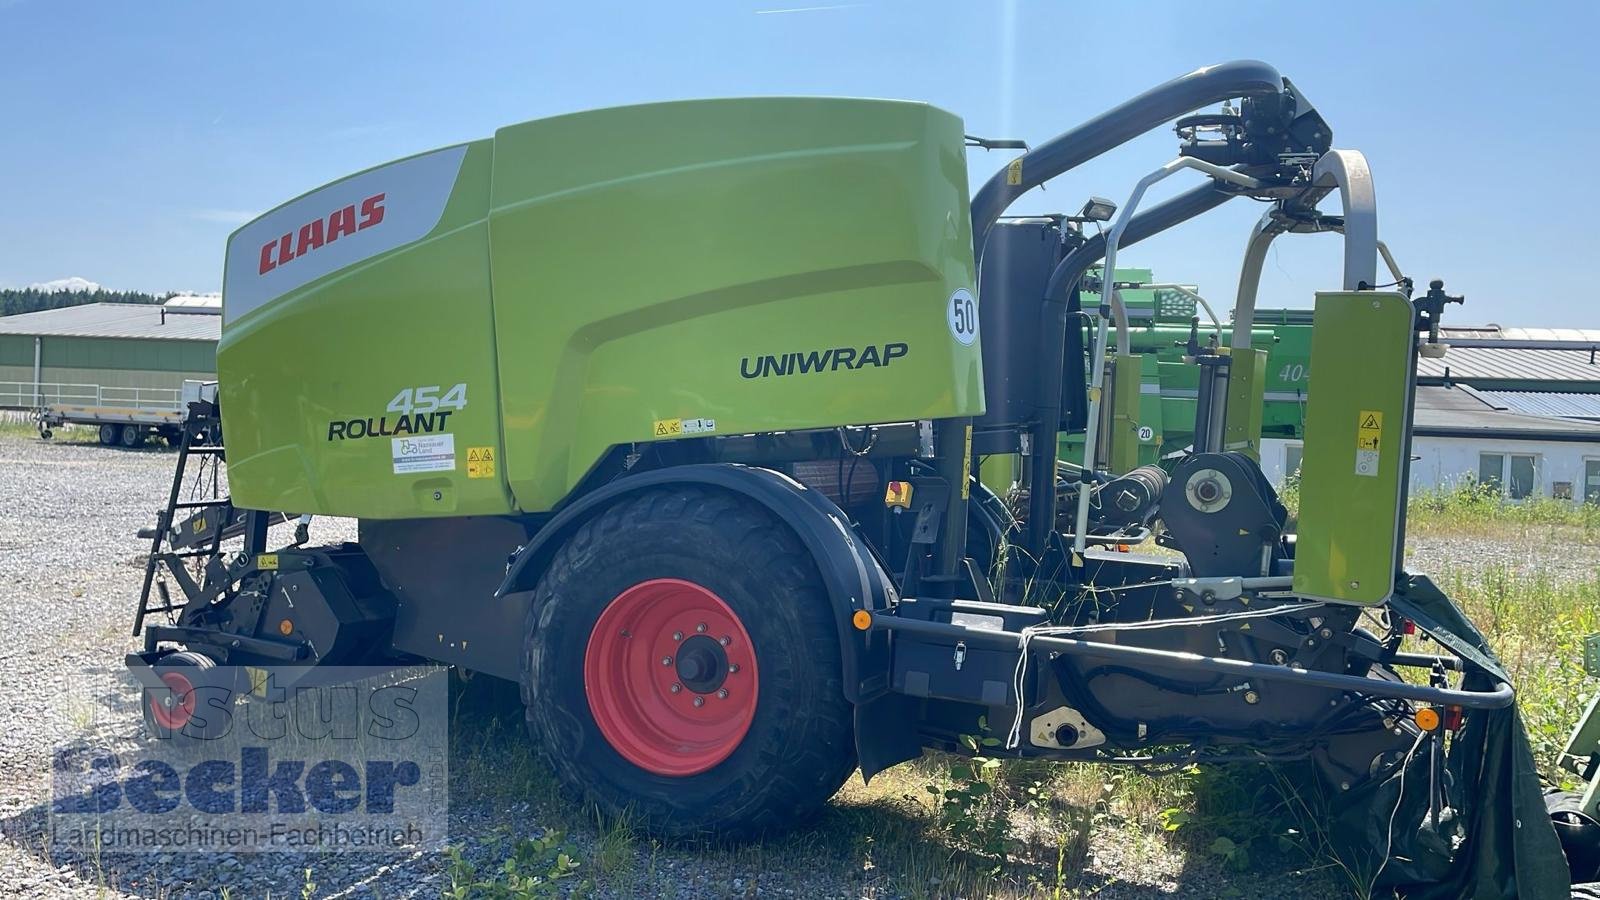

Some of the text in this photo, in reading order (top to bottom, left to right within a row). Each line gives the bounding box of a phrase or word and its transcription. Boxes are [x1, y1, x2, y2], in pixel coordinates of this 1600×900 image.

[259, 193, 385, 275] CLAAS
[954, 299, 974, 334] 50
[740, 342, 908, 379] UNIWRAP
[386, 383, 467, 414] 454
[328, 411, 452, 441] ROLLANT
[1141, 428, 1150, 439] 20
